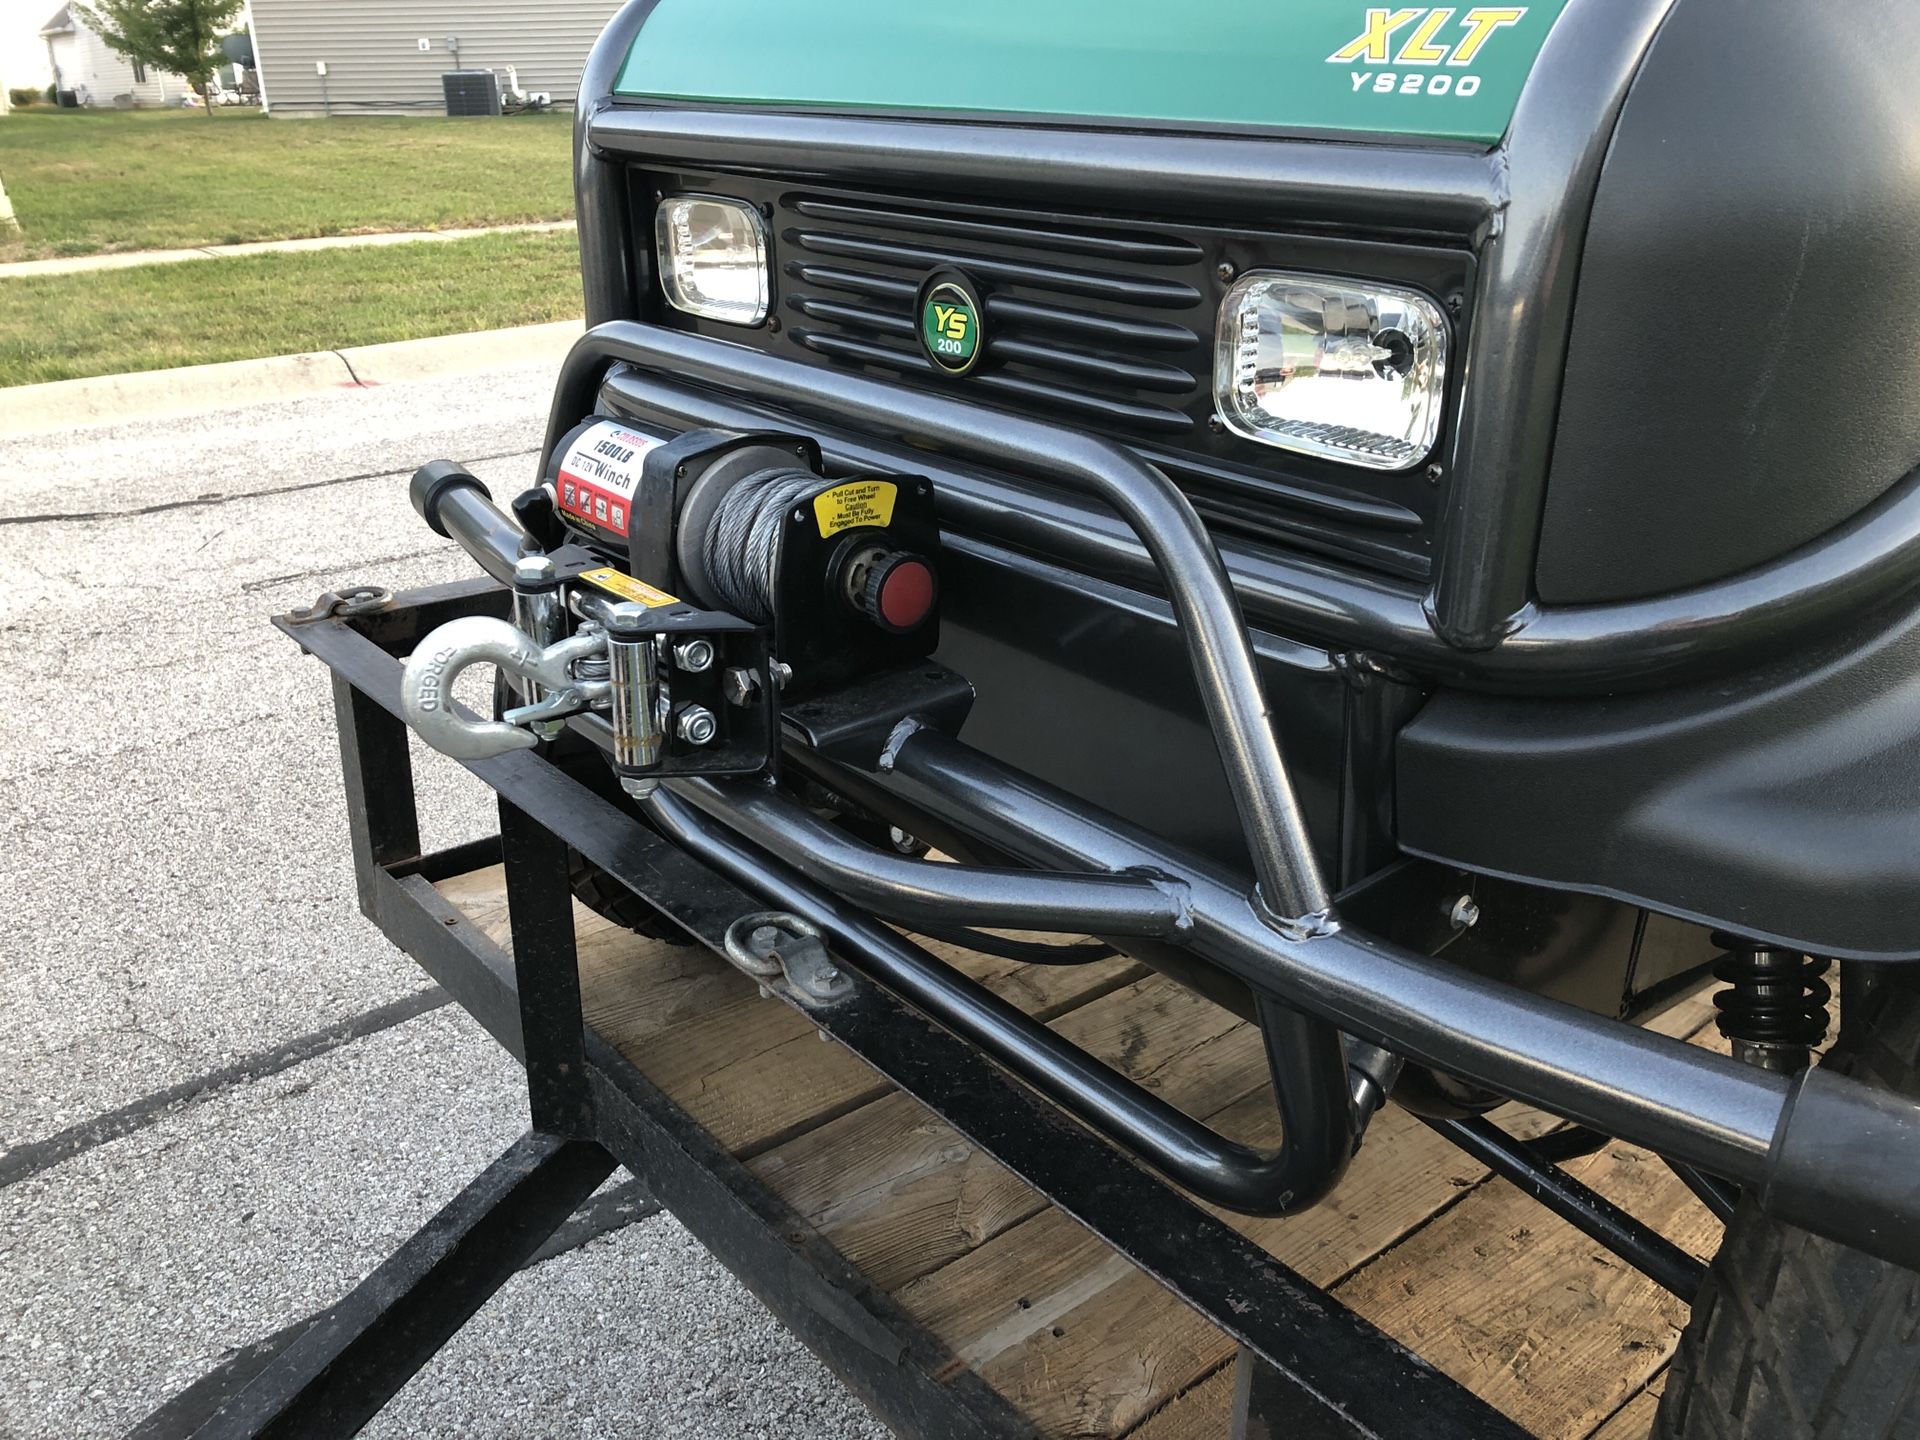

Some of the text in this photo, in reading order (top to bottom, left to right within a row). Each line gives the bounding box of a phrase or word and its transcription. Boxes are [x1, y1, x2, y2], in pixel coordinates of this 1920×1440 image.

[1324, 7, 1529, 66] XLT
[1351, 72, 1481, 96] YS200
[934, 305, 968, 340] YS
[937, 338, 962, 354] 200
[594, 440, 635, 464] 1500LB
[582, 460, 594, 473] 12V
[595, 460, 631, 489] Winch
[832, 490, 843, 498] Pull
[855, 486, 867, 494] and
[858, 493, 876, 501] Wheel
[829, 518, 855, 528] Engaged
[863, 513, 881, 521] Power
[837, 511, 852, 520] Must
[860, 508, 874, 516] Fully
[418, 647, 458, 713] FORGED
